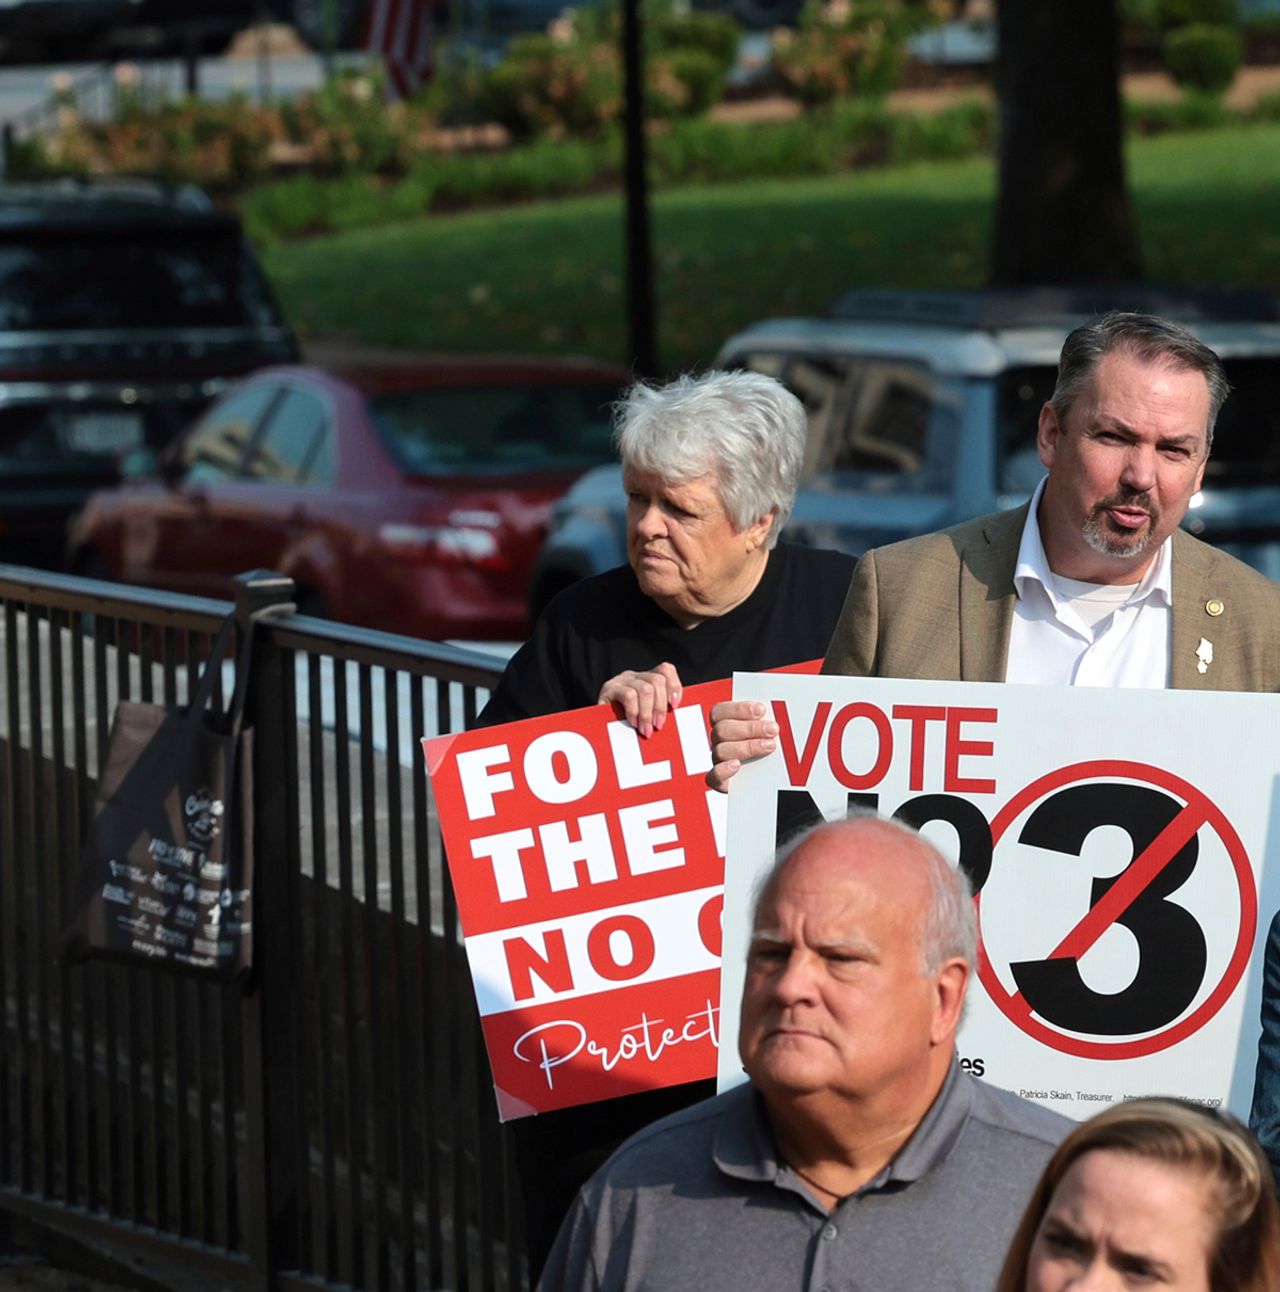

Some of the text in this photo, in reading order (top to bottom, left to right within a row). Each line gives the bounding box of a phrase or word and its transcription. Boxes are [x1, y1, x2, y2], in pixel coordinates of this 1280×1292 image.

[771, 700, 998, 794] VOTE
[470, 798, 686, 903] THE
[1009, 782, 1208, 1035] 3
[502, 914, 656, 1002] NO
[513, 998, 720, 1090] Protect
[1020, 1089, 1048, 1100] Patricia
[1049, 1089, 1074, 1101] Skain,
